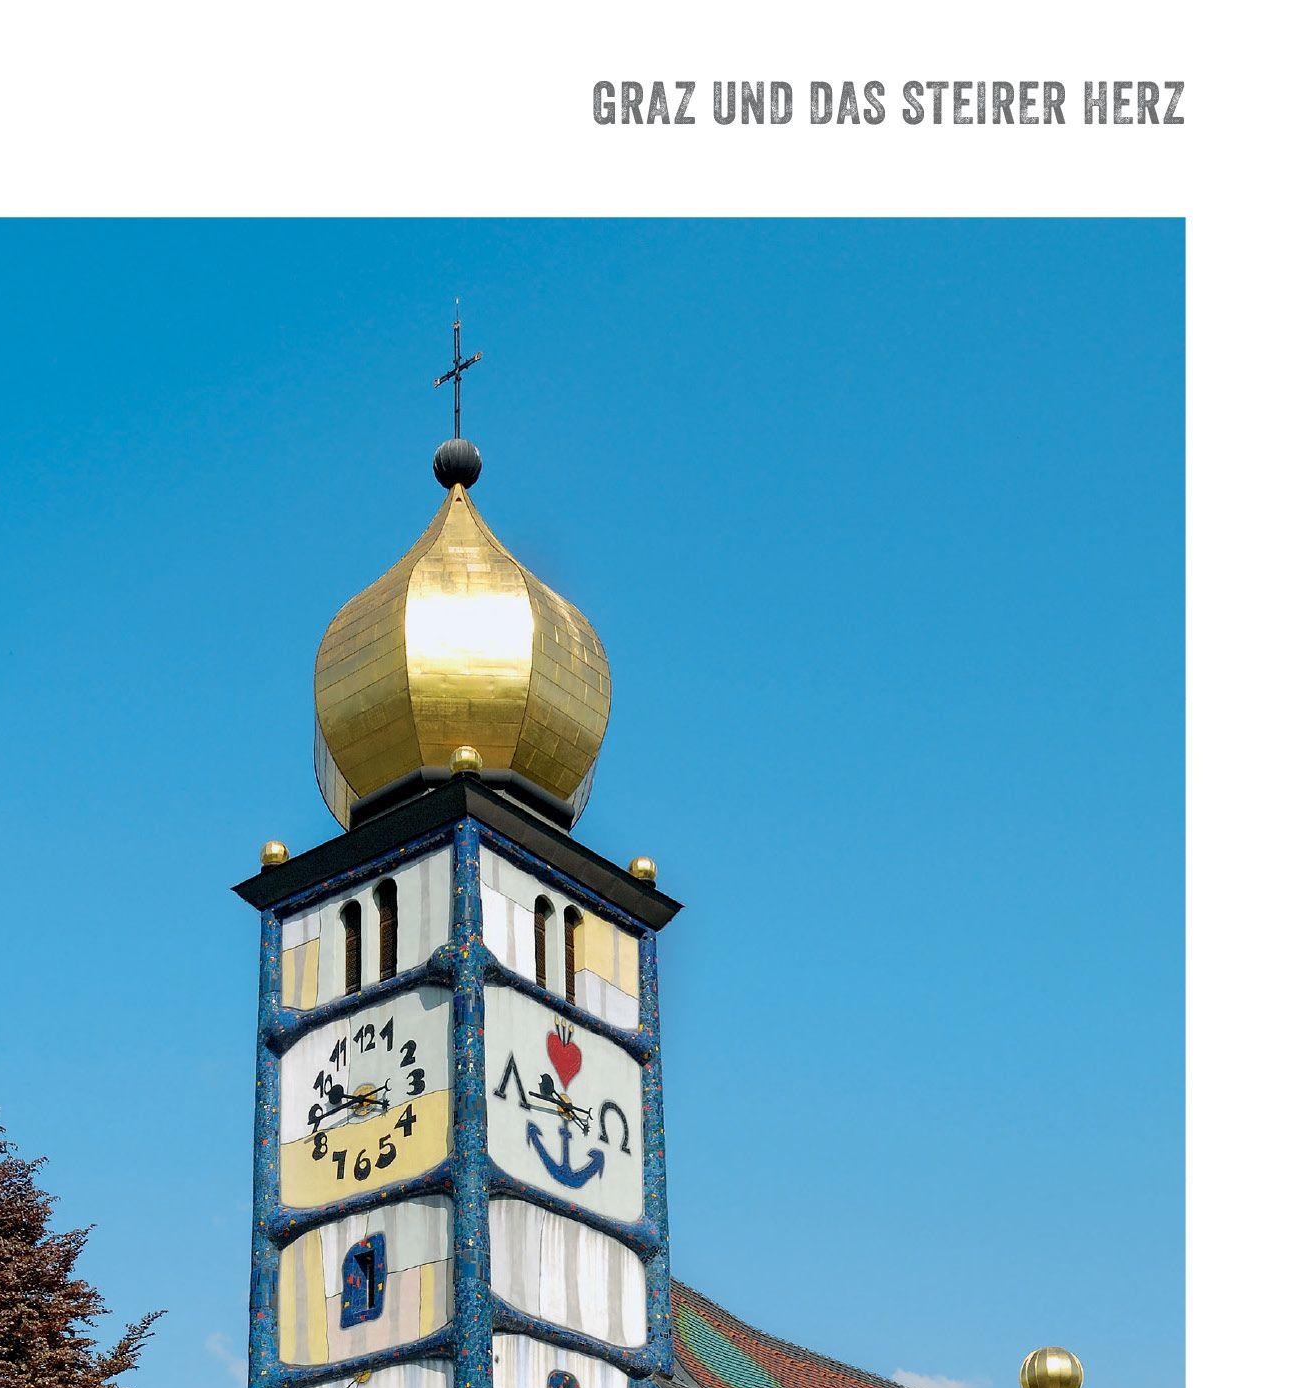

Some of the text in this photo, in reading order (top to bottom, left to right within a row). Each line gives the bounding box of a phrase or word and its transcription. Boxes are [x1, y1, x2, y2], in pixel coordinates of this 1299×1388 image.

[592, 80, 1185, 126] GRAZ UND DAS STEIRER HERZ
[353, 1023, 376, 1054] 12
[379, 1016, 394, 1052] 1
[329, 1036, 347, 1072] 11
[400, 1040, 417, 1068] 2
[312, 1070, 333, 1099] 10
[406, 1068, 426, 1096] 3
[307, 1103, 324, 1134] 9
[394, 1104, 417, 1138] 4
[312, 1132, 328, 1161] 8
[375, 1134, 397, 1169] 5
[332, 1150, 347, 1180] 7
[353, 1149, 371, 1181] 6
